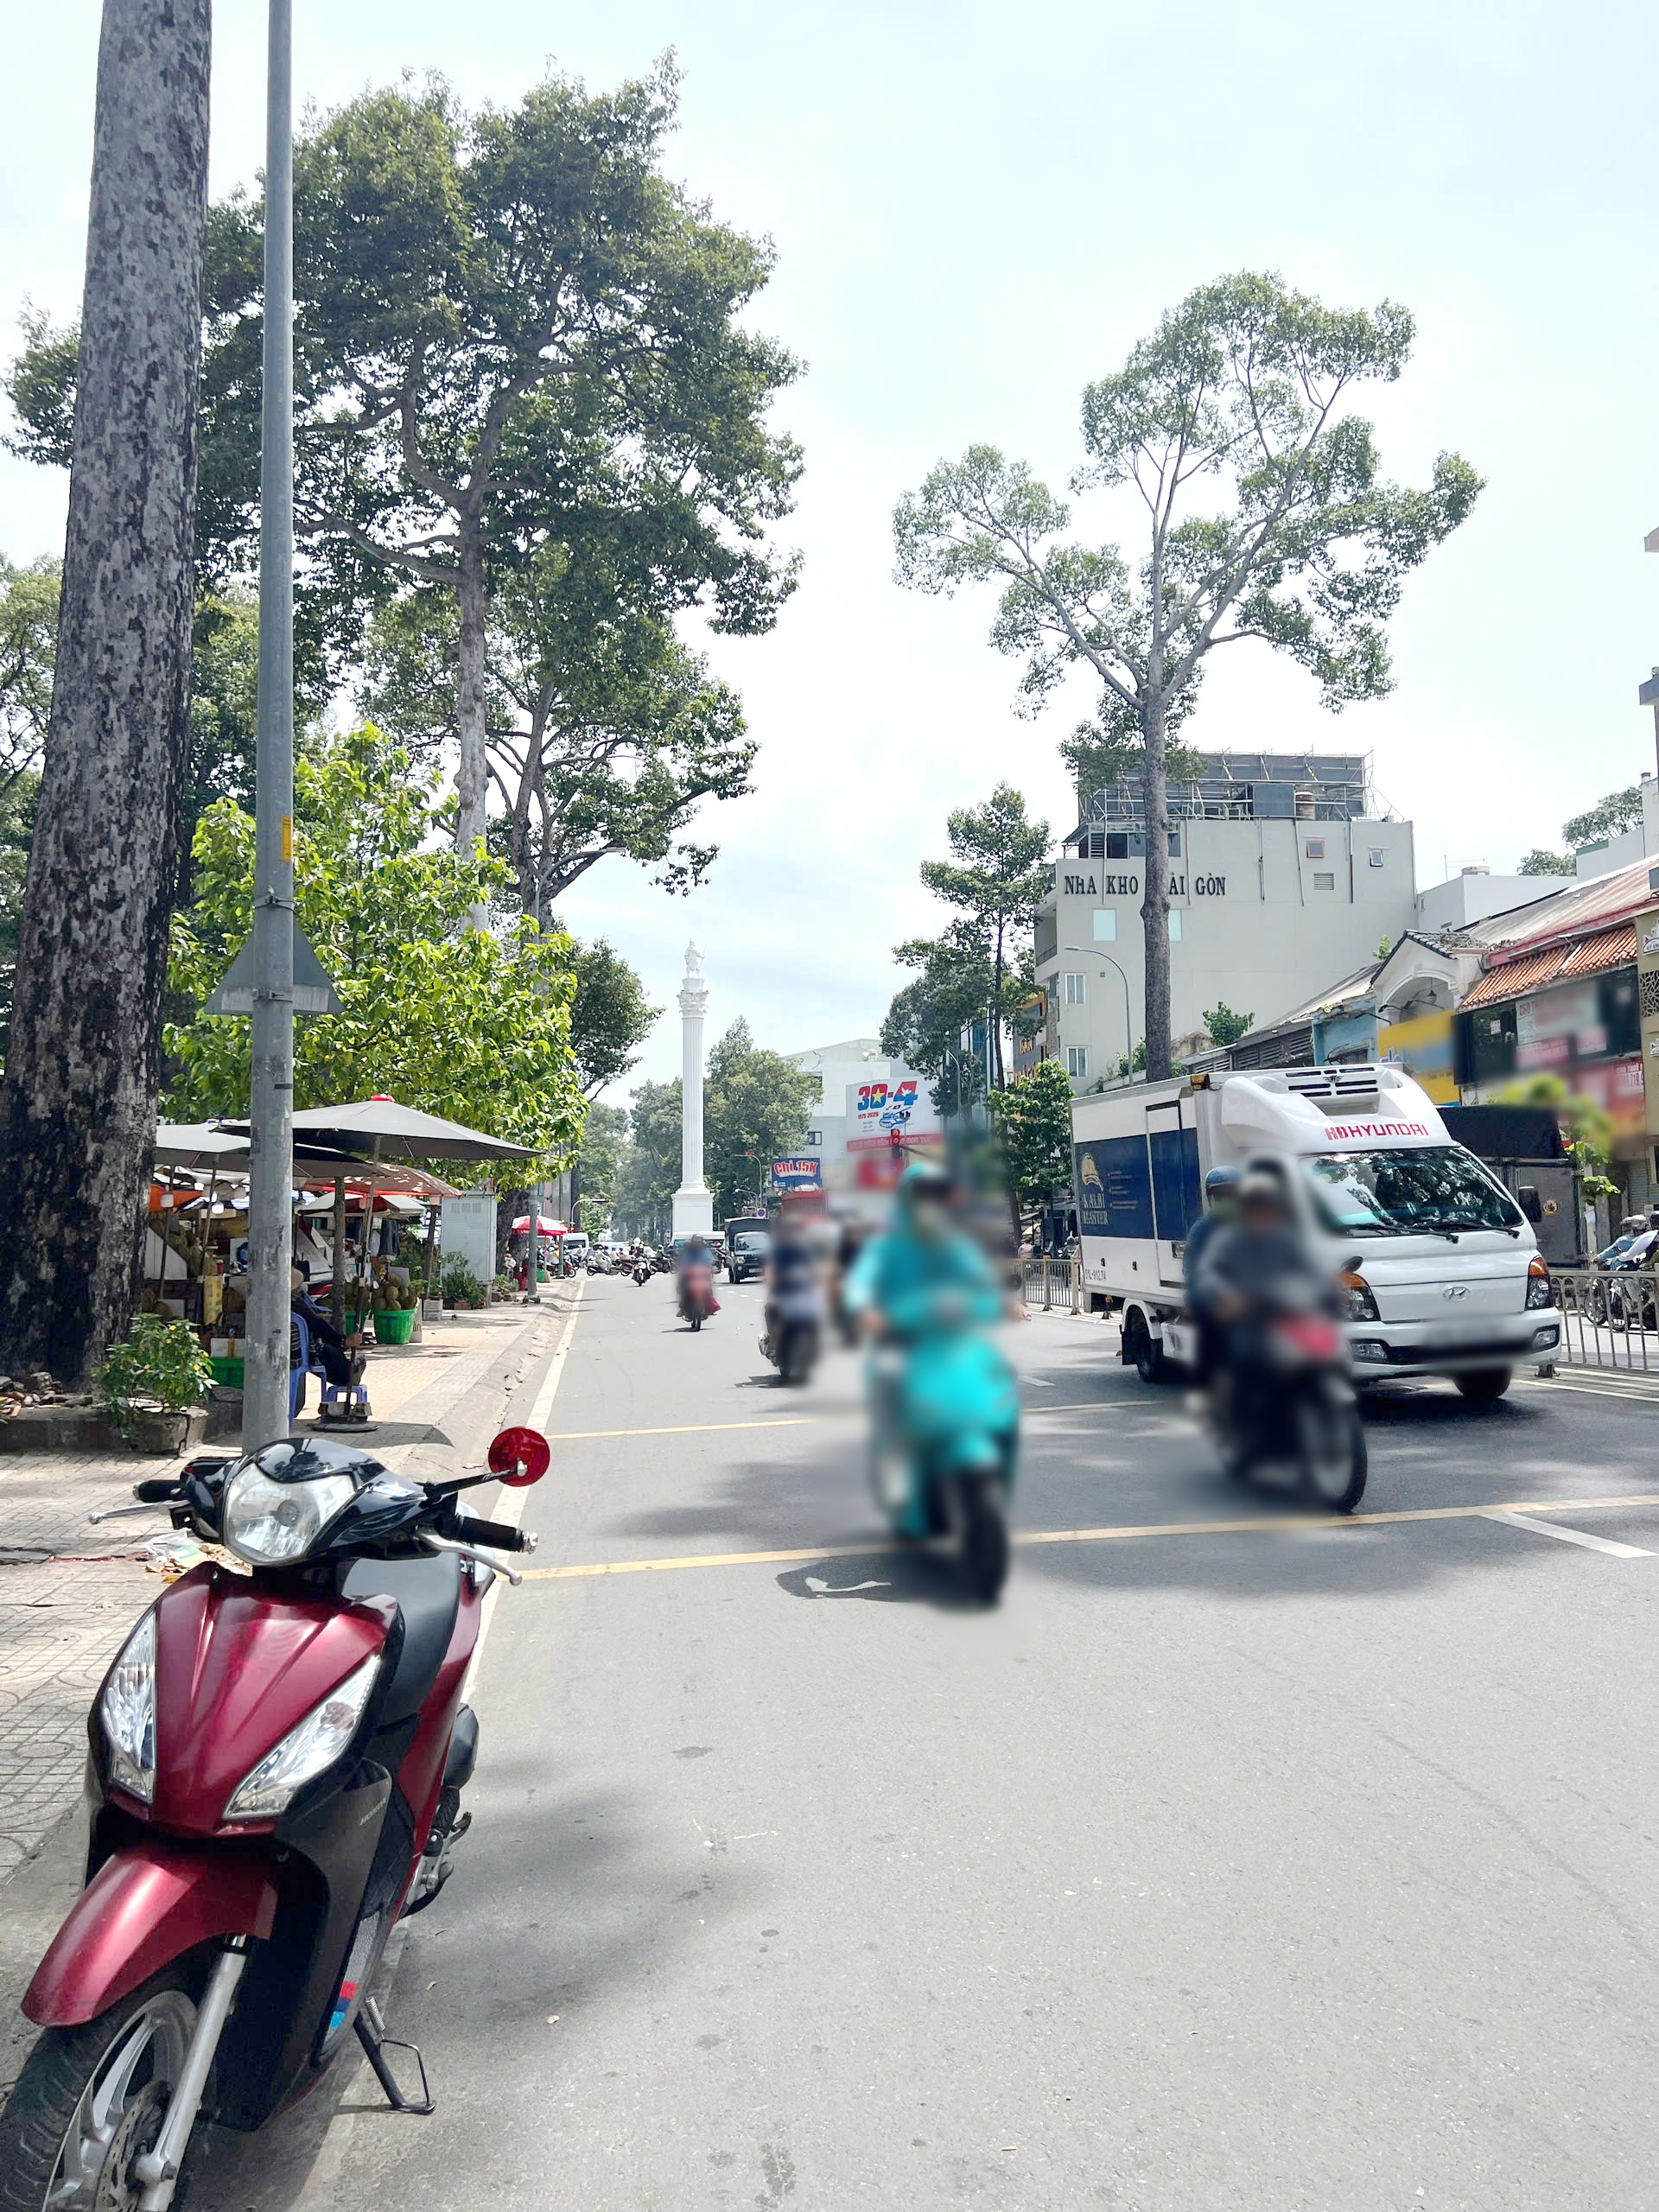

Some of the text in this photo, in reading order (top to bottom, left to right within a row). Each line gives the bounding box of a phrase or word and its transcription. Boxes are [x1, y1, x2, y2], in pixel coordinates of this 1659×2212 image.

[1106, 875, 1139, 895] KHO
[1168, 872, 1185, 895] ÀI
[1195, 873, 1226, 896] GÒN
[857, 1080, 918, 1111] 30-4
[1347, 1124, 1429, 1138] HYUNDAI
